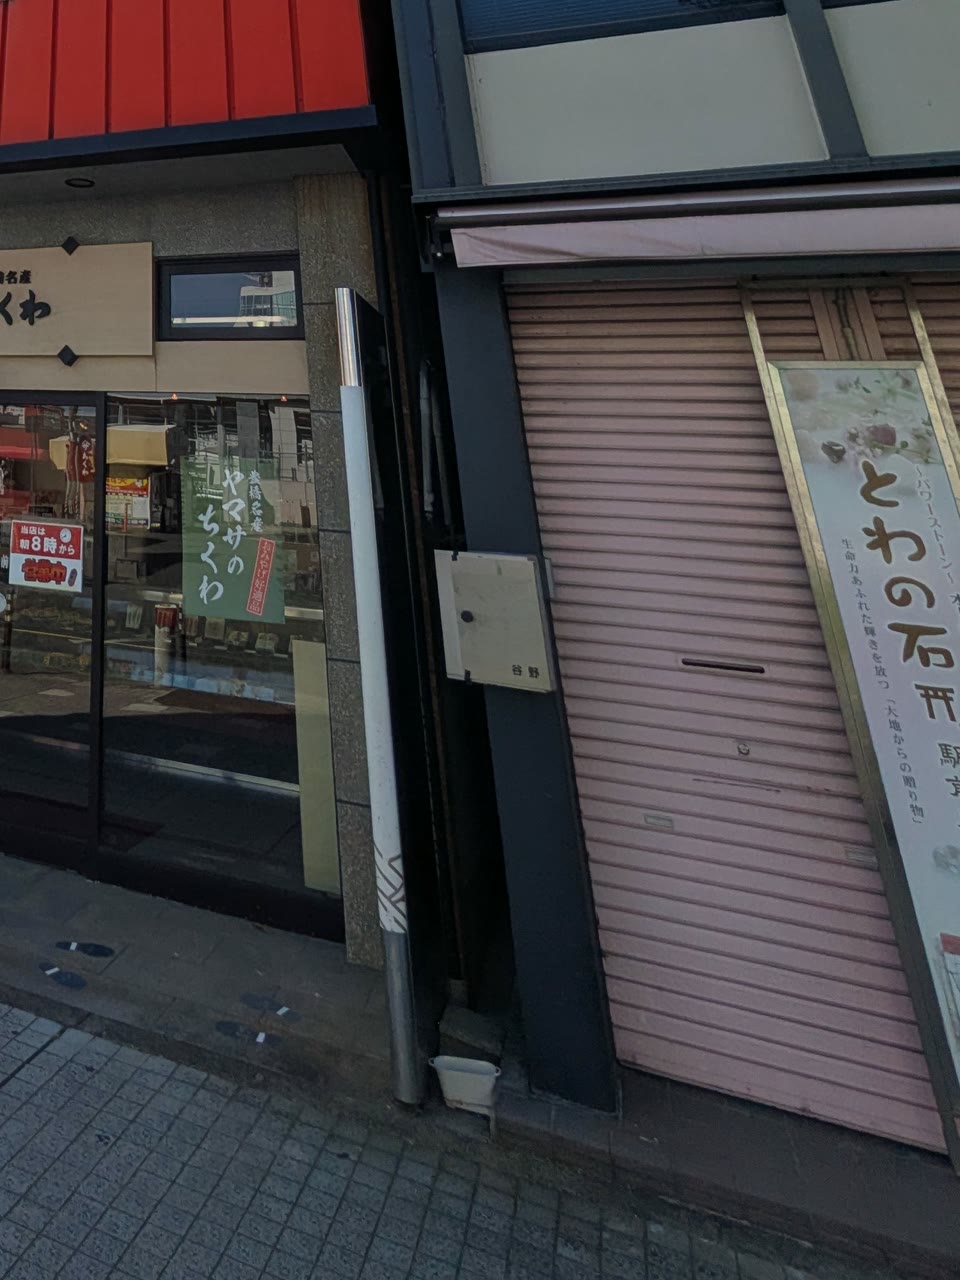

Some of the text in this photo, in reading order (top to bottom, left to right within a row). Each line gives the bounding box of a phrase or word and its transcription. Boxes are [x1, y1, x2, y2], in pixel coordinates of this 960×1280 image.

[19, 535, 75, 556] 朝8時から
[20, 525, 46, 536] 当店は
[197, 503, 225, 605] ちくわ
[222, 469, 247, 576] ヤマサの
[859, 460, 956, 669] とわの石
